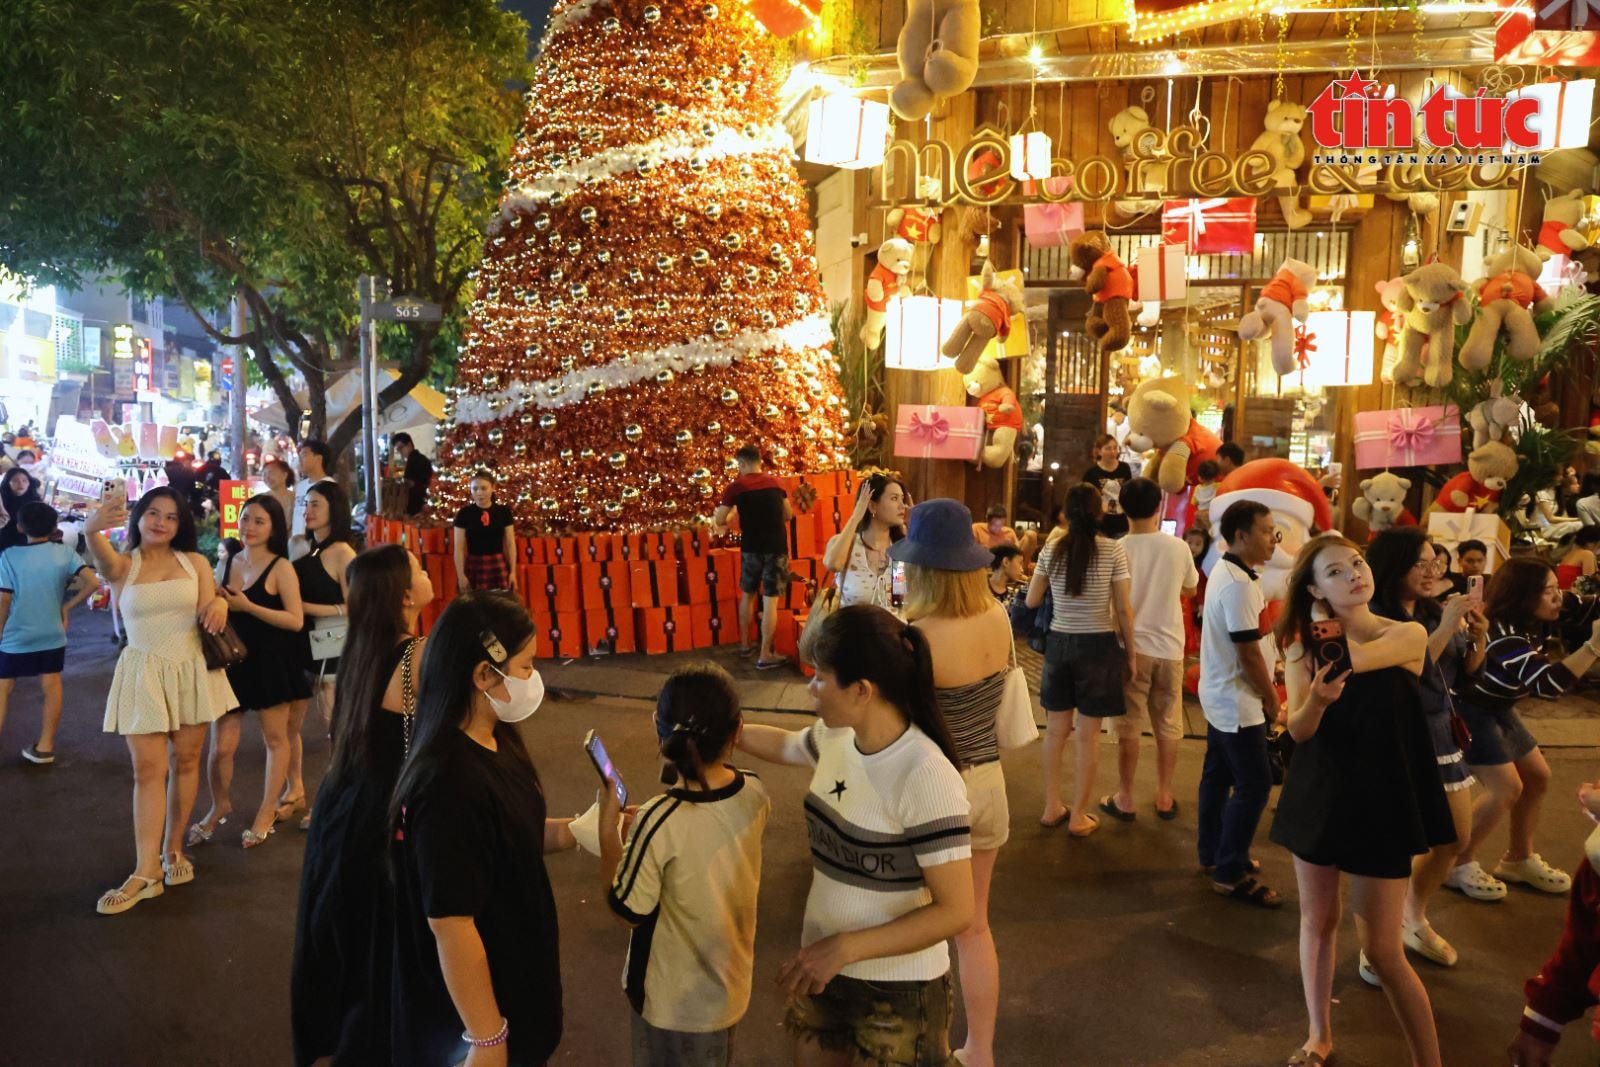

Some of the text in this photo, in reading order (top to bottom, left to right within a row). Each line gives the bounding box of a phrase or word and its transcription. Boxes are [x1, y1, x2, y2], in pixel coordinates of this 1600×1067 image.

[882, 122, 1016, 206] mê
[1035, 126, 1278, 202] coffee
[412, 306, 420, 317] 5
[841, 845, 896, 873] DIOR
